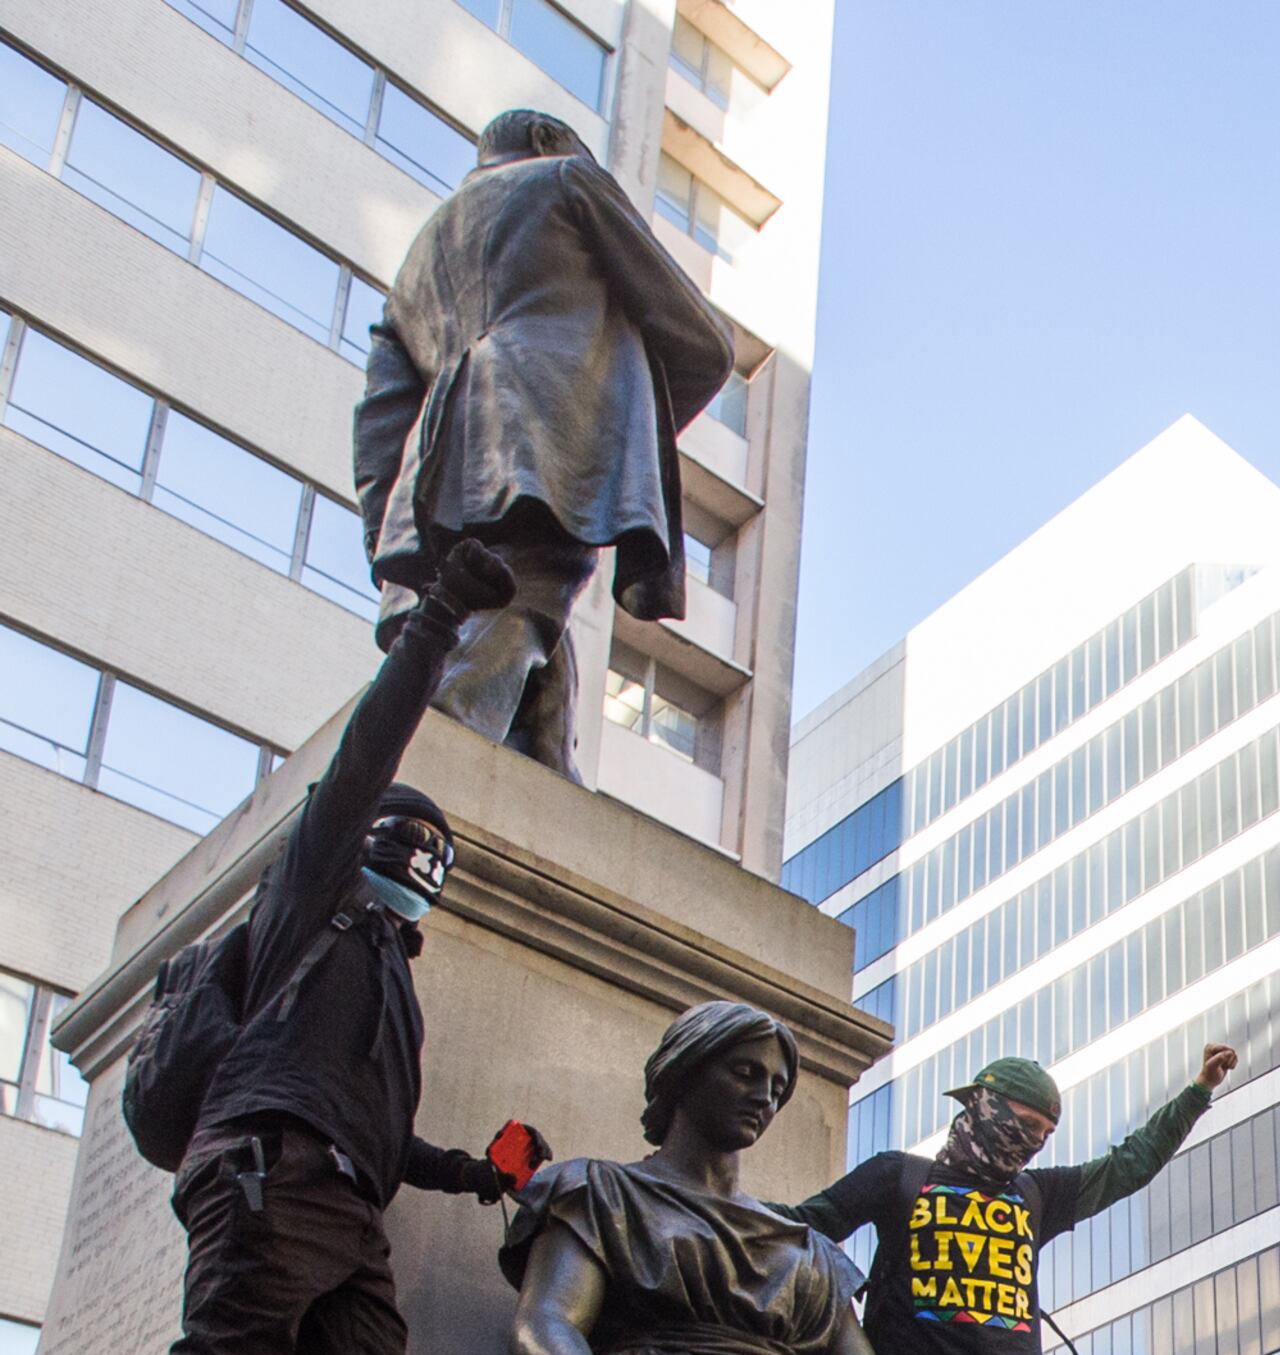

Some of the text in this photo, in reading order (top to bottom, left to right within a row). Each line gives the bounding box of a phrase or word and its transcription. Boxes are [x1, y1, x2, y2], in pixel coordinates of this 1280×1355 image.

[909, 1196, 1034, 1241] BLACK
[909, 1230, 1033, 1286] LIVES
[910, 1275, 1033, 1320] MATTER
